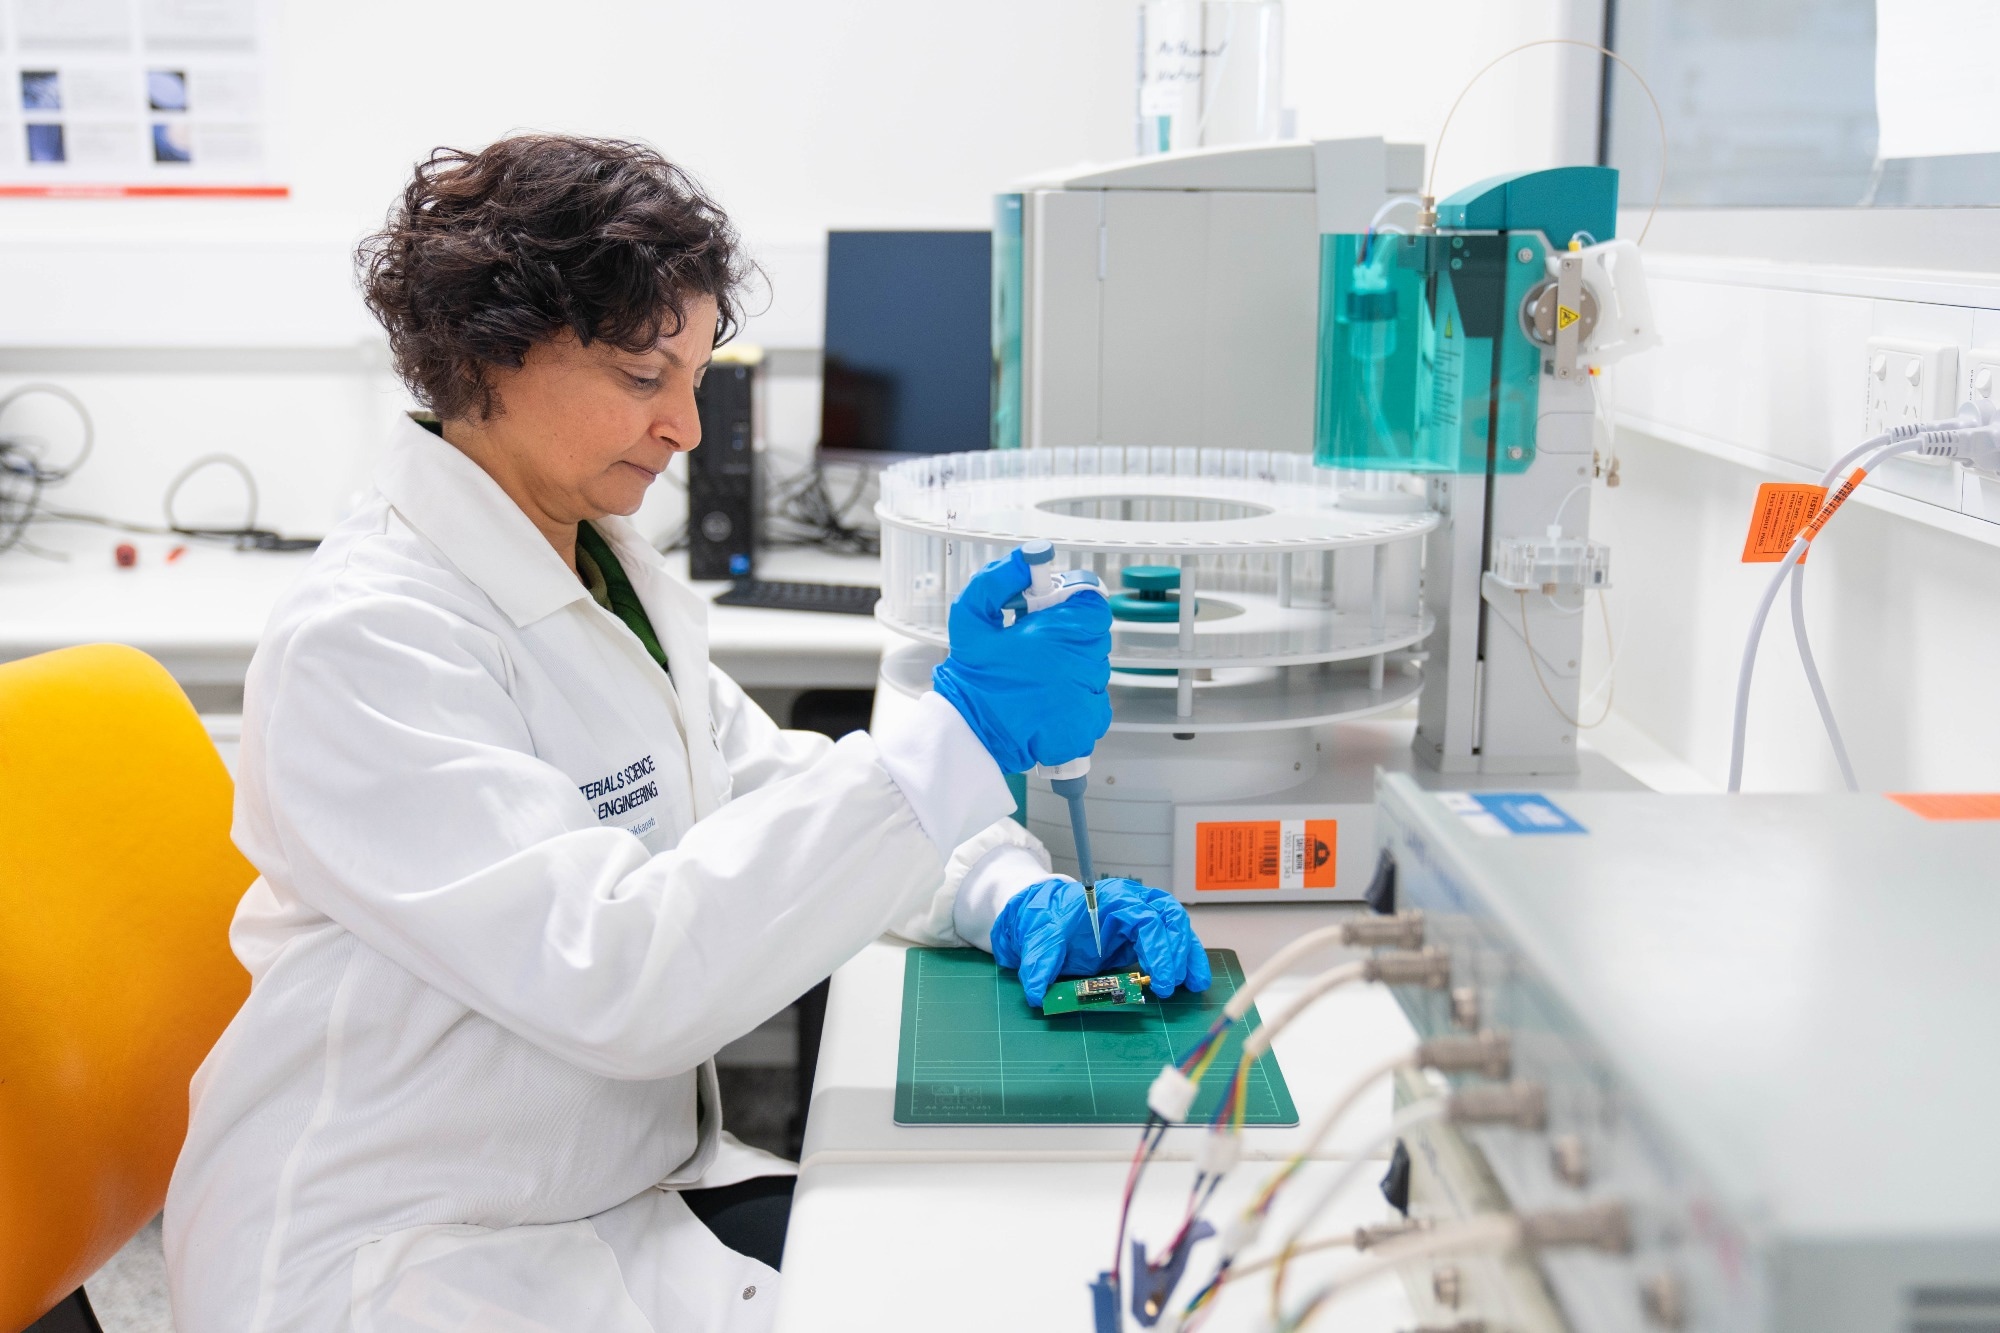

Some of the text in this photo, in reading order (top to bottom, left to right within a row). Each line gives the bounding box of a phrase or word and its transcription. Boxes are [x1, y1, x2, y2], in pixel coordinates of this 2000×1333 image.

[1807, 496, 1818, 519] TESTED
[624, 755, 656, 785] SCIENCE
[598, 780, 658, 820] ENGINEERING
